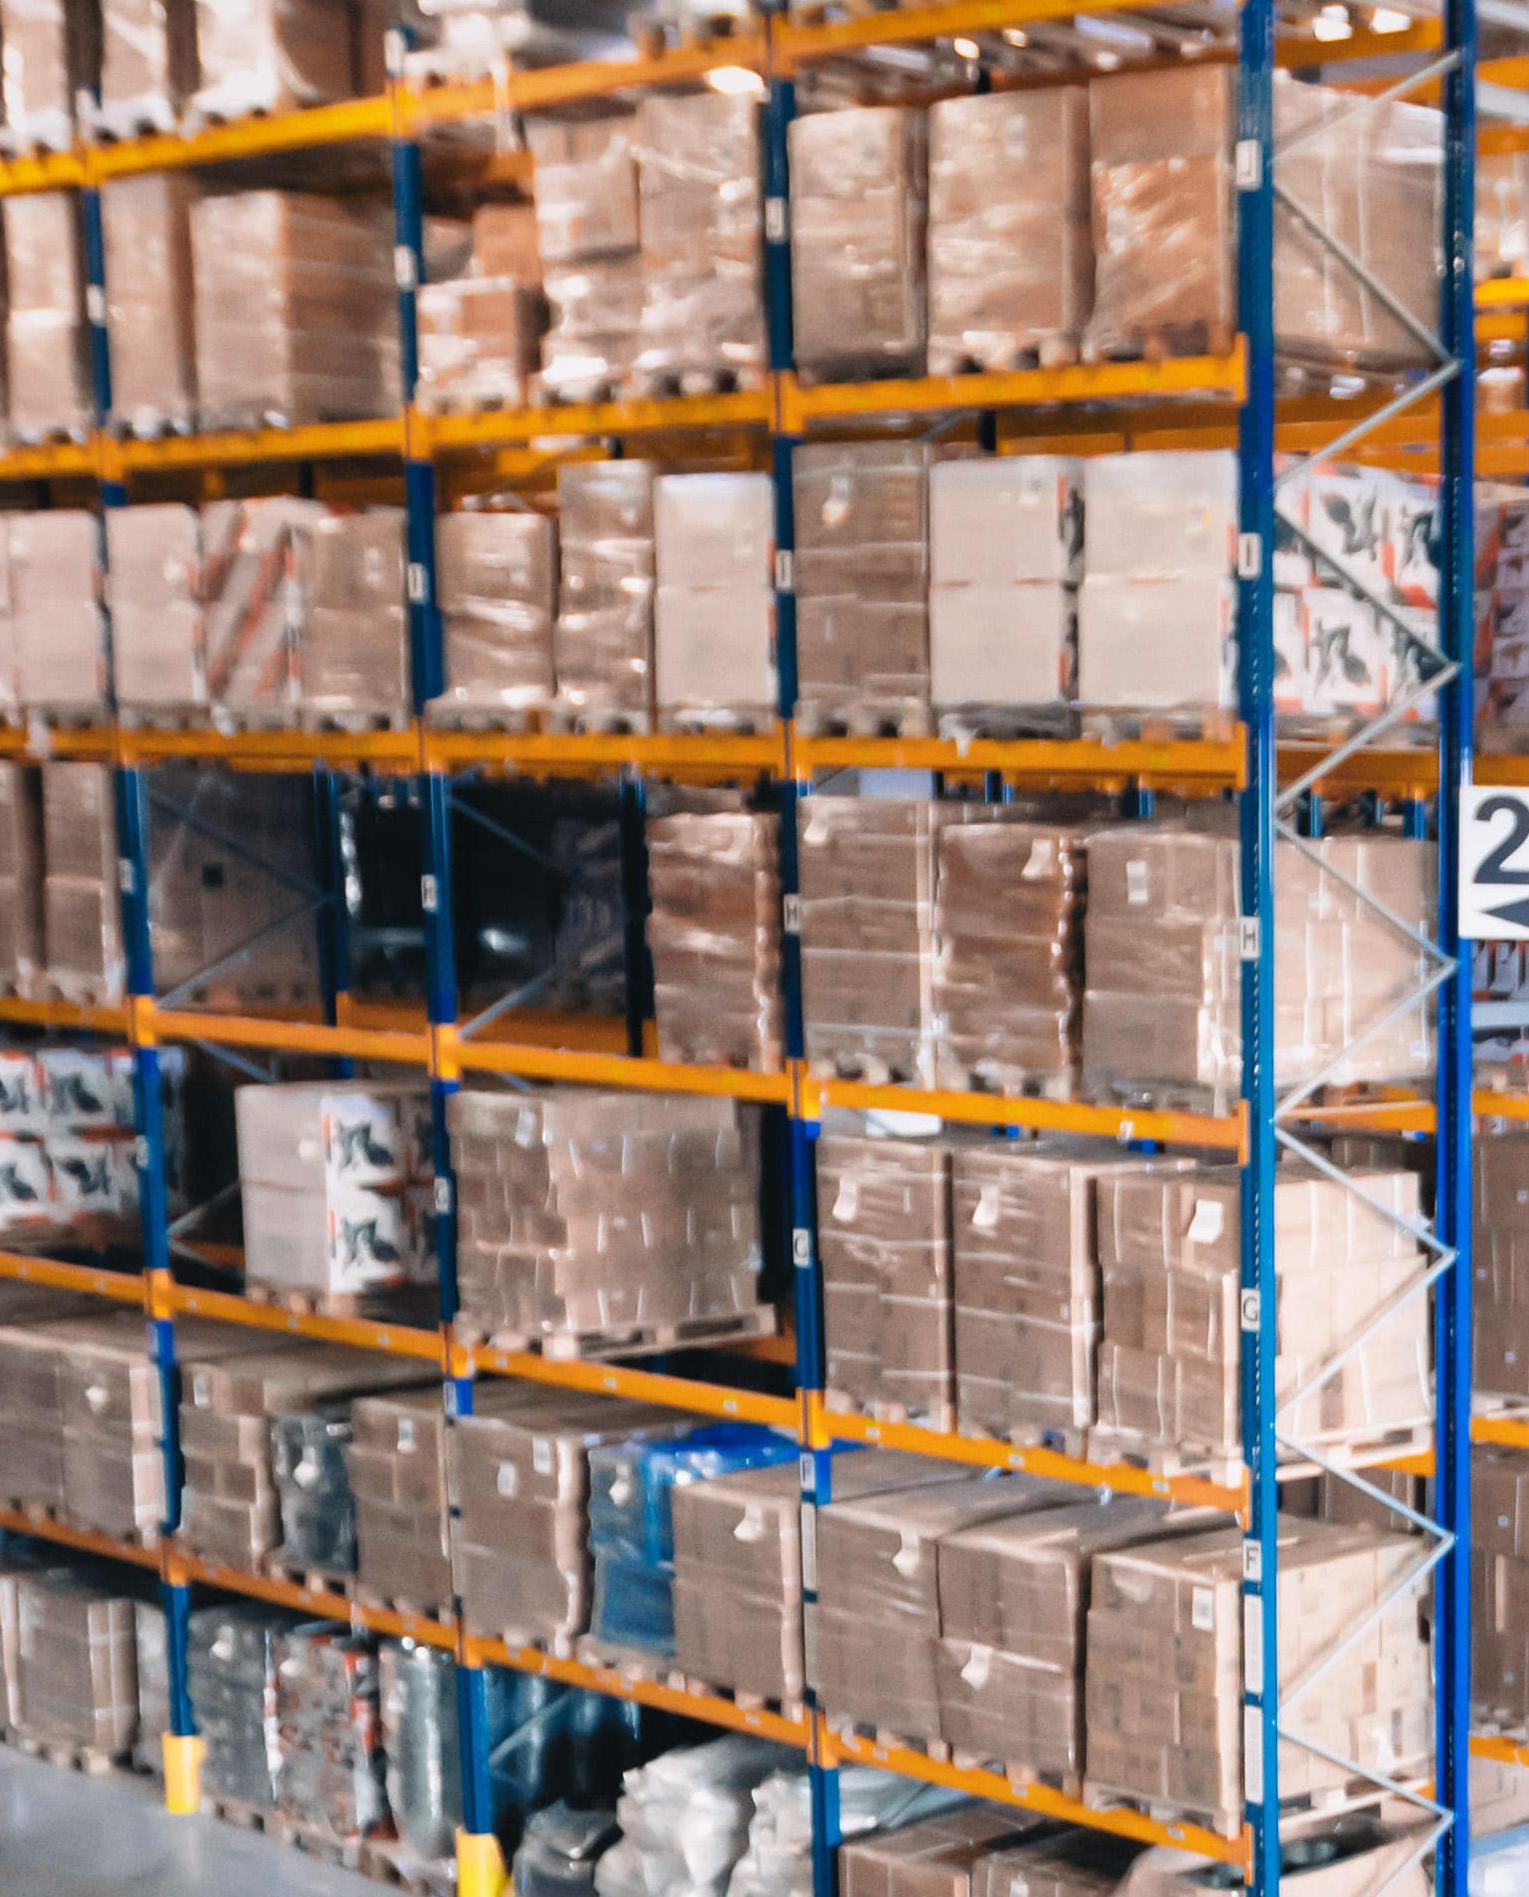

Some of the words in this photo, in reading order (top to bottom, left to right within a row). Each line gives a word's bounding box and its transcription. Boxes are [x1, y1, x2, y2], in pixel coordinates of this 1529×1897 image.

[786, 902, 797, 922] H
[1241, 924, 1256, 951] H
[792, 1236, 807, 1259] G
[1241, 1296, 1257, 1323] G
[1245, 1547, 1258, 1571] F
